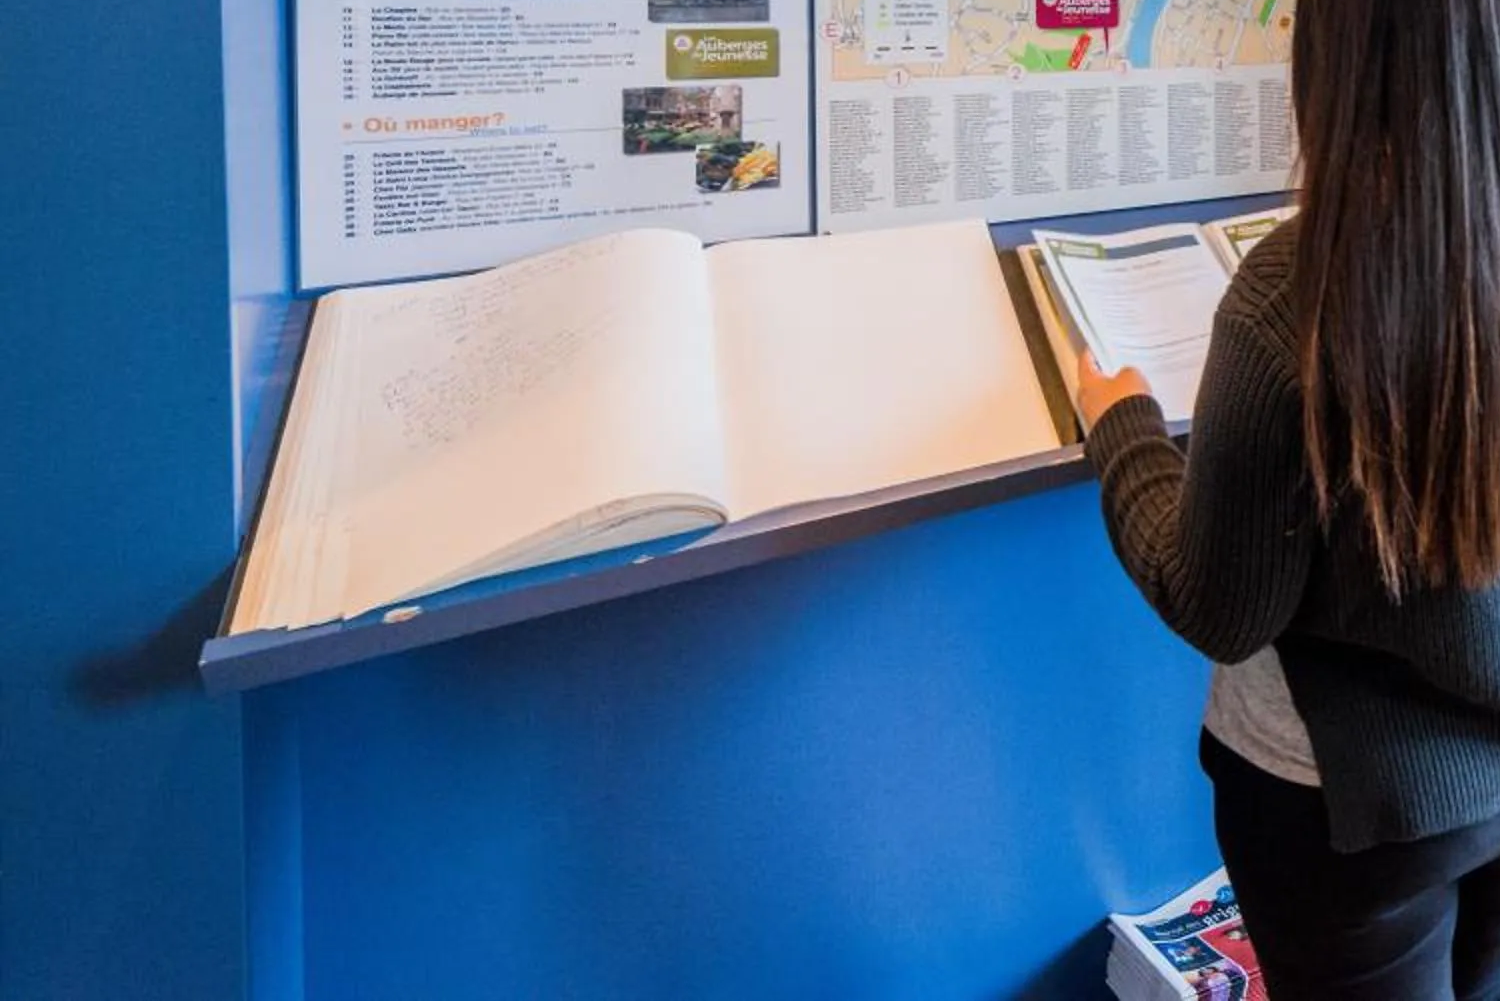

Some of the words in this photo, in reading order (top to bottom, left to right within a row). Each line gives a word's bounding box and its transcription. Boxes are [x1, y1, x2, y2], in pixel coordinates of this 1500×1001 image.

[825, 22, 838, 38] E
[364, 116, 397, 132] Où
[405, 112, 505, 131] manger?
